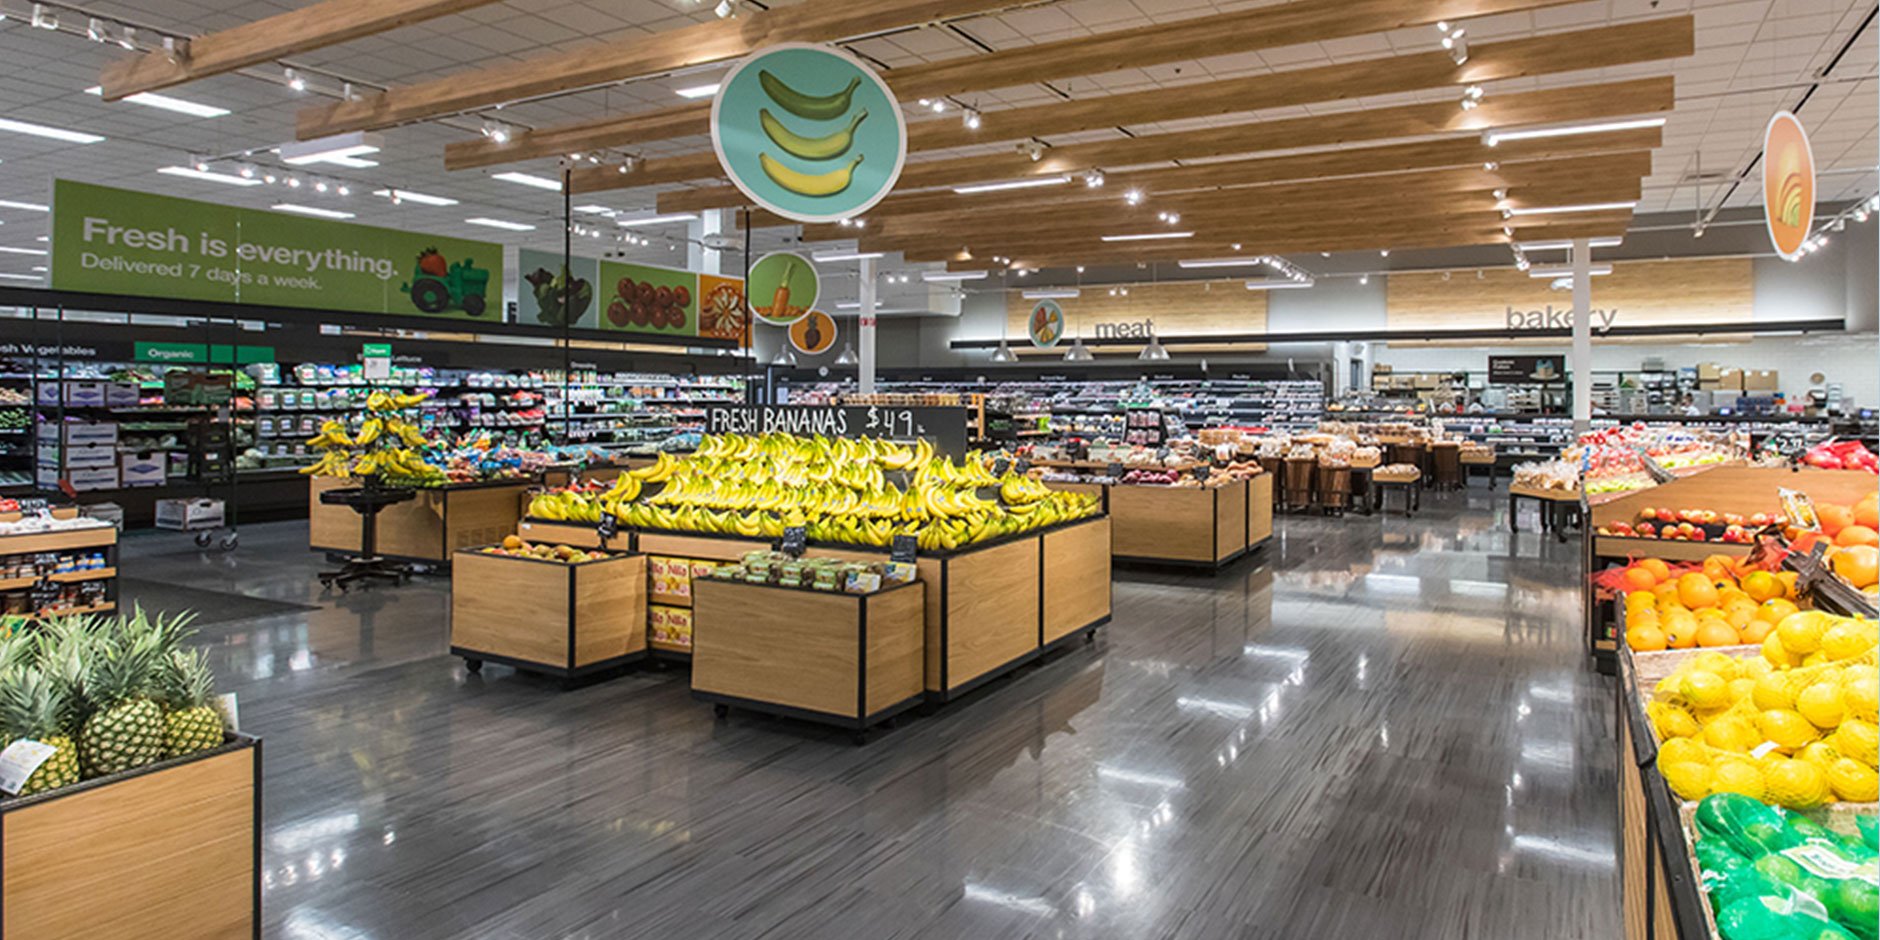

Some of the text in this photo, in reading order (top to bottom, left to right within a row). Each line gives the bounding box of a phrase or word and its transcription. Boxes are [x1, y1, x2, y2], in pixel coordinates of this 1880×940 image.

[82, 216, 400, 281] Fresh is everything.
[80, 251, 322, 291] Delivered 7 days a week.
[1095, 317, 1154, 338] meat
[147, 347, 195, 360] Organic
[711, 407, 759, 433] FRESH
[763, 407, 848, 435] BANANAS
